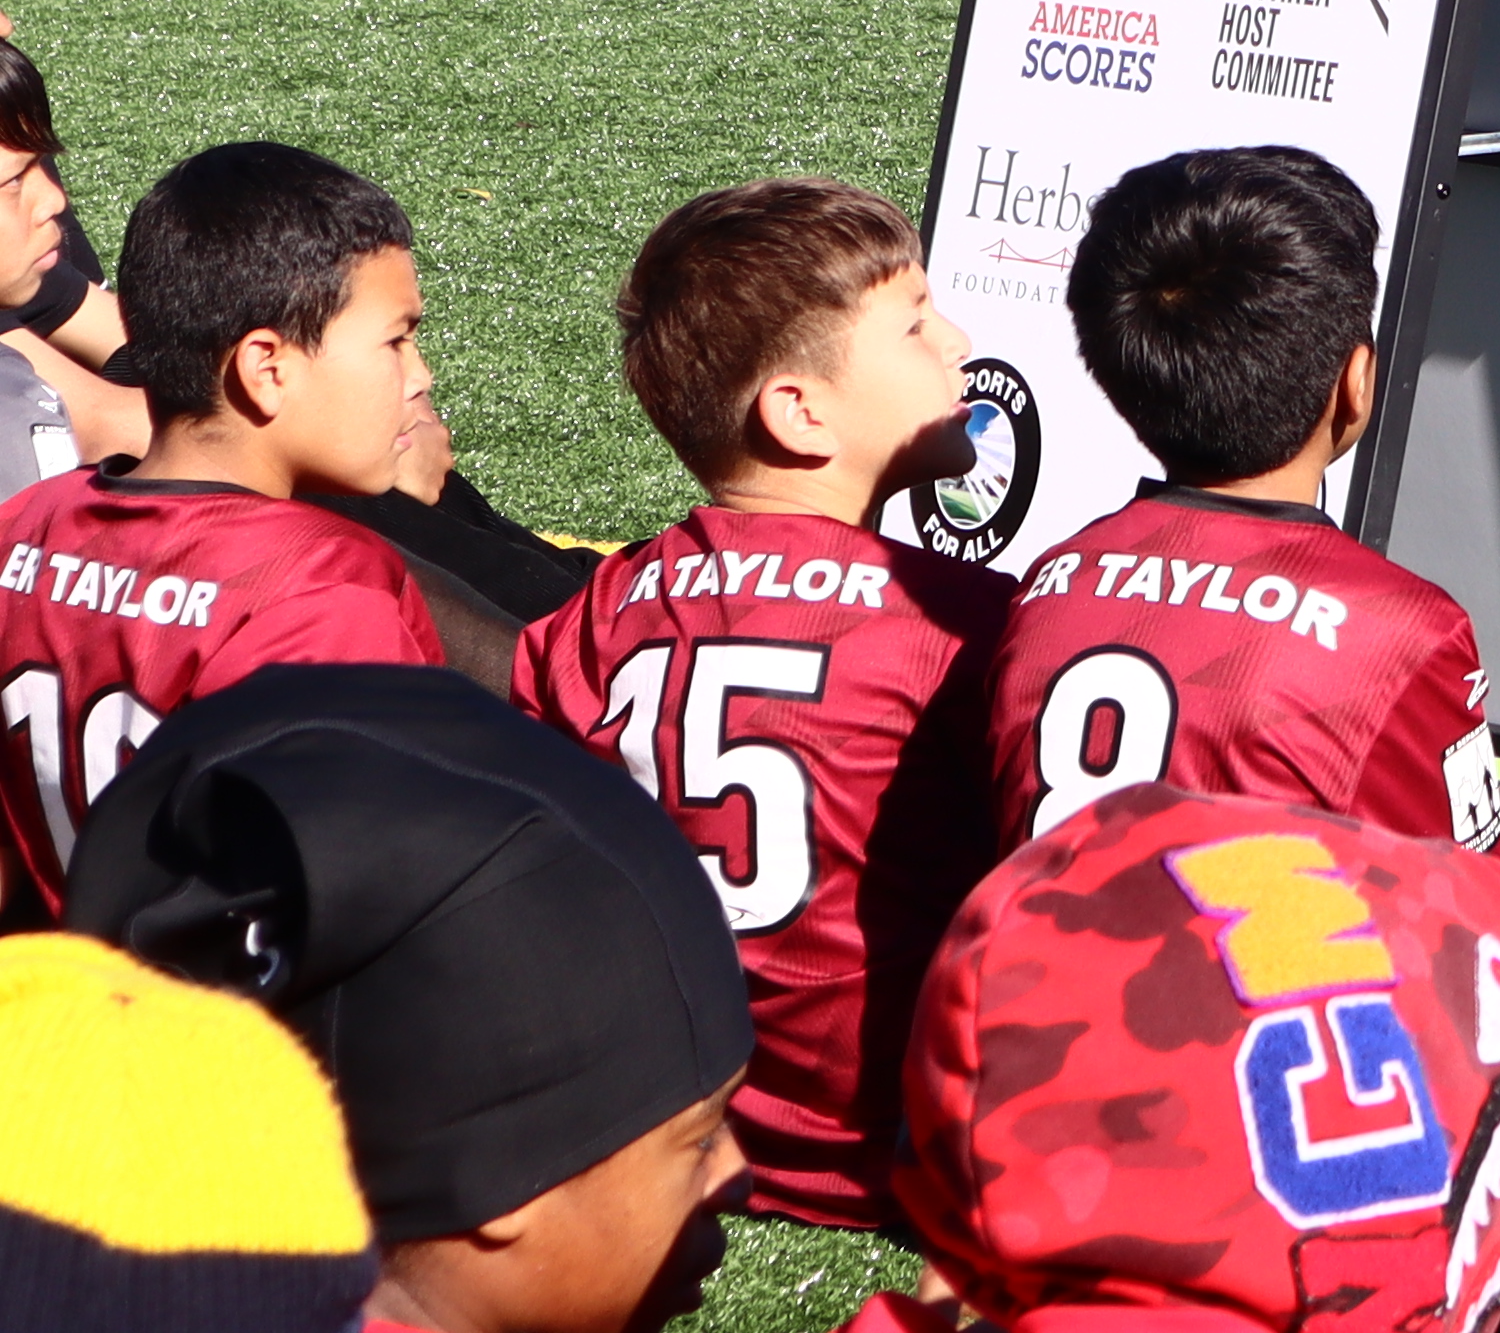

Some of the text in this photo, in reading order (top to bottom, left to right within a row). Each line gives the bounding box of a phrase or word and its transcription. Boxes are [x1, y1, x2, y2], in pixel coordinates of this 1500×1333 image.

[1028, 1, 1160, 47] AMERICA
[1219, 2, 1281, 49] HOST
[1021, 39, 1156, 93] SCORES
[1211, 49, 1339, 103] COMMITTEE
[965, 145, 1098, 233] Herbs
[951, 271, 1068, 305] FOUNDAT
[963, 367, 1027, 416] PORTS
[922, 513, 1004, 563] FOR ALL
[0, 541, 218, 627] ER TAYLOR
[668, 549, 890, 610] TAYLOR
[1019, 551, 1349, 651] ER TAYLOR
[595, 637, 827, 937] 15
